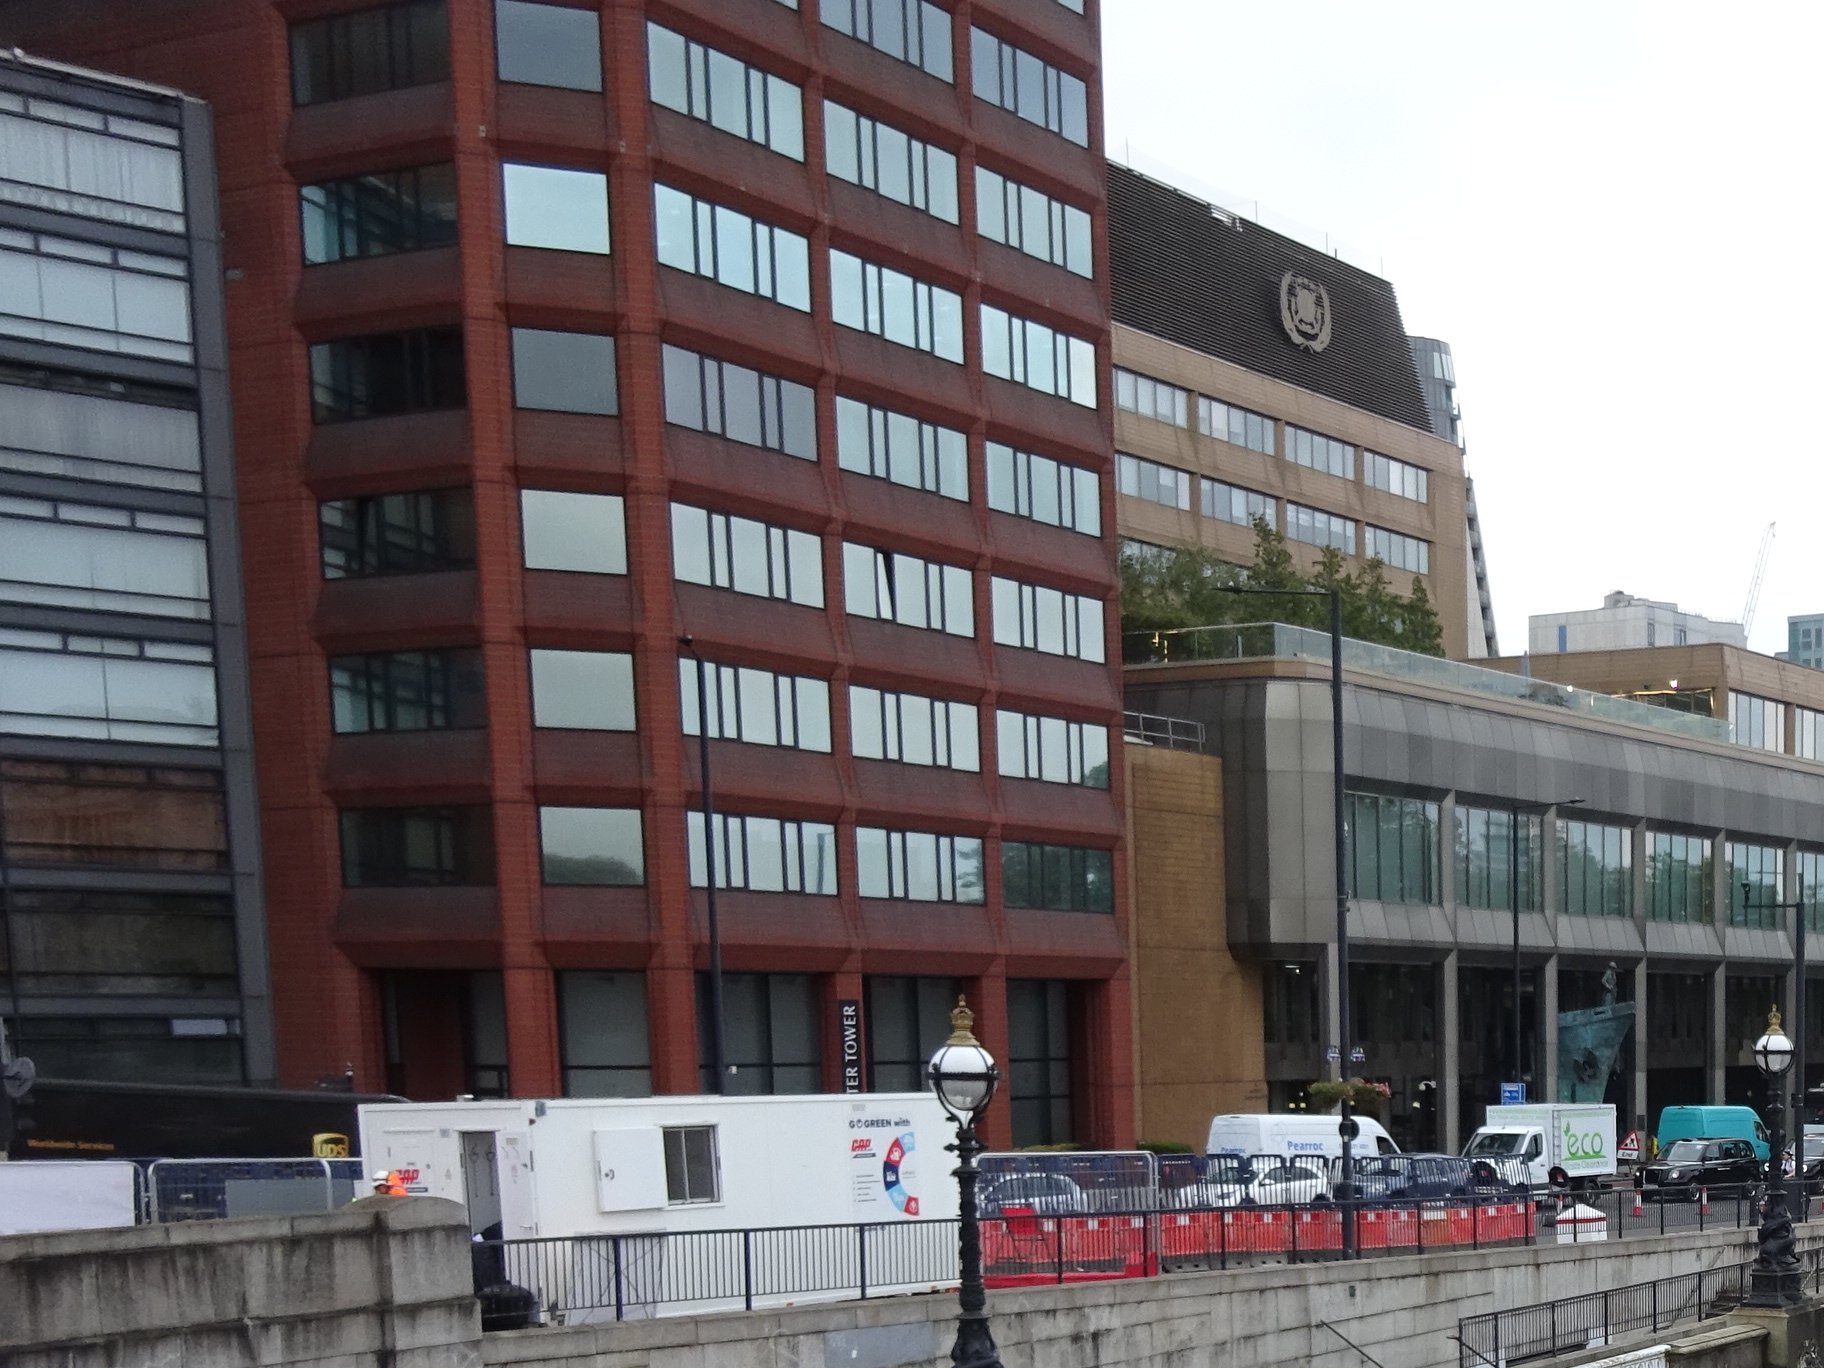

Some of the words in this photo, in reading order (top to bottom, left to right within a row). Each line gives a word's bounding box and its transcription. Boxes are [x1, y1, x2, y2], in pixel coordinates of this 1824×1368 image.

[843, 1005, 858, 1062] TOWER
[864, 1119, 892, 1128] GREEN
[1287, 1140, 1324, 1151] Pearroc
[1567, 1132, 1603, 1155] eco
